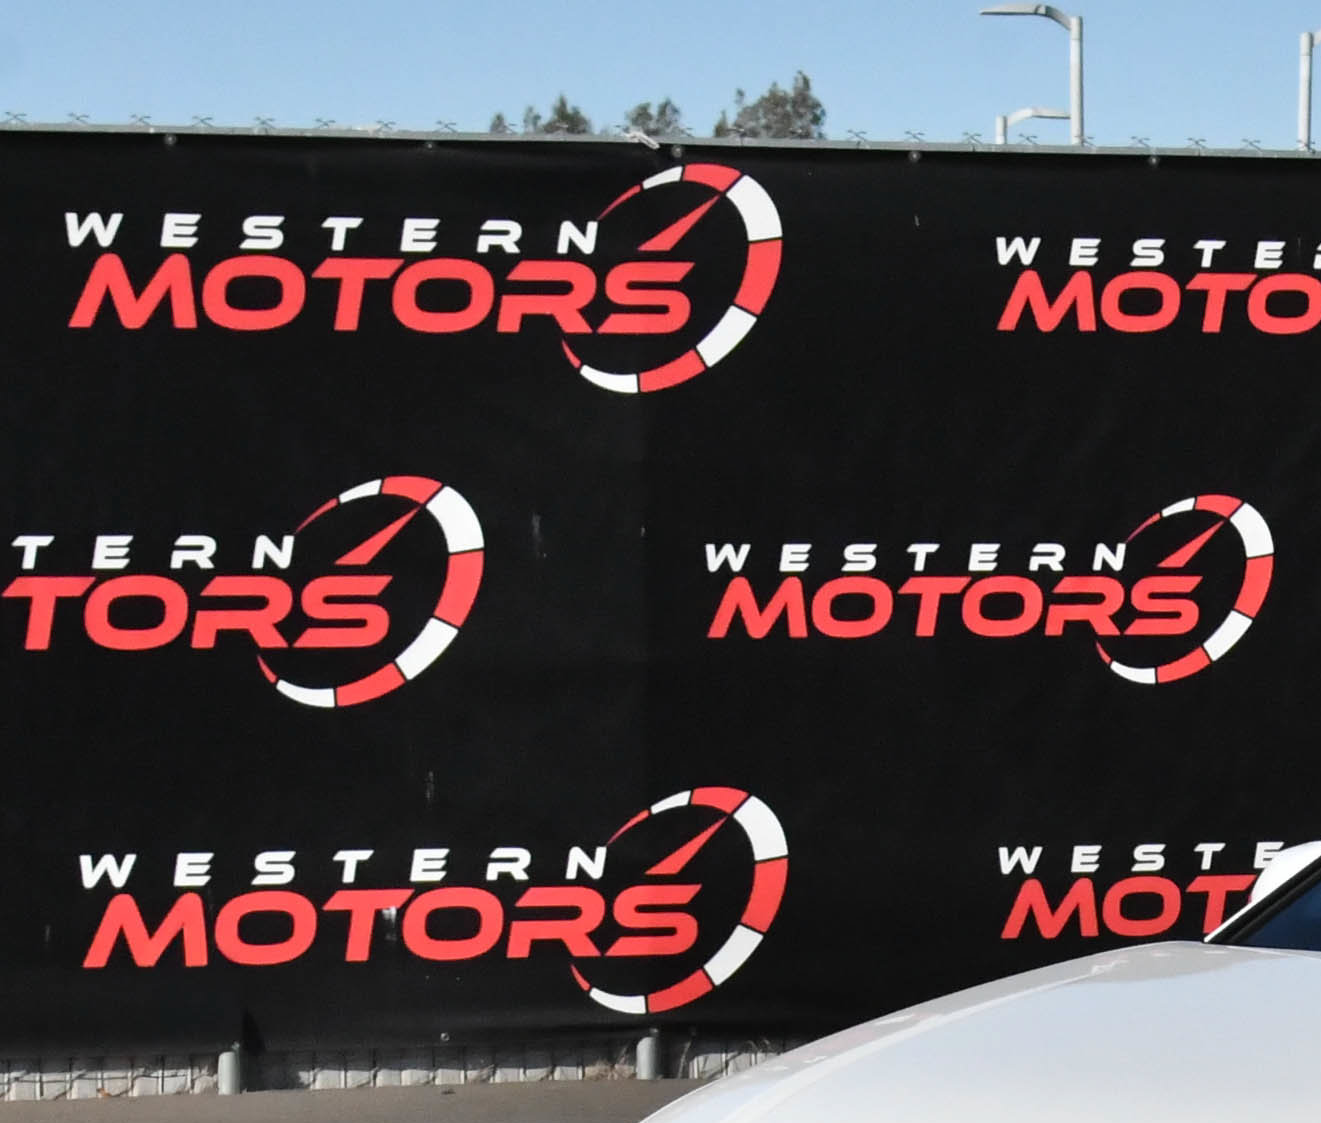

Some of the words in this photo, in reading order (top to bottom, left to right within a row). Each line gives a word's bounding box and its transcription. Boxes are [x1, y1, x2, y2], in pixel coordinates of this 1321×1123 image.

[66, 213, 598, 254] WESTERN
[69, 252, 694, 334] MOTORS
[12, 535, 294, 569] TERN
[706, 543, 1126, 572] WESTERN
[2, 575, 392, 650] TORS
[708, 576, 1202, 639] MOTORS
[80, 847, 606, 888] WESTERN
[83, 884, 701, 968] MOTORS
